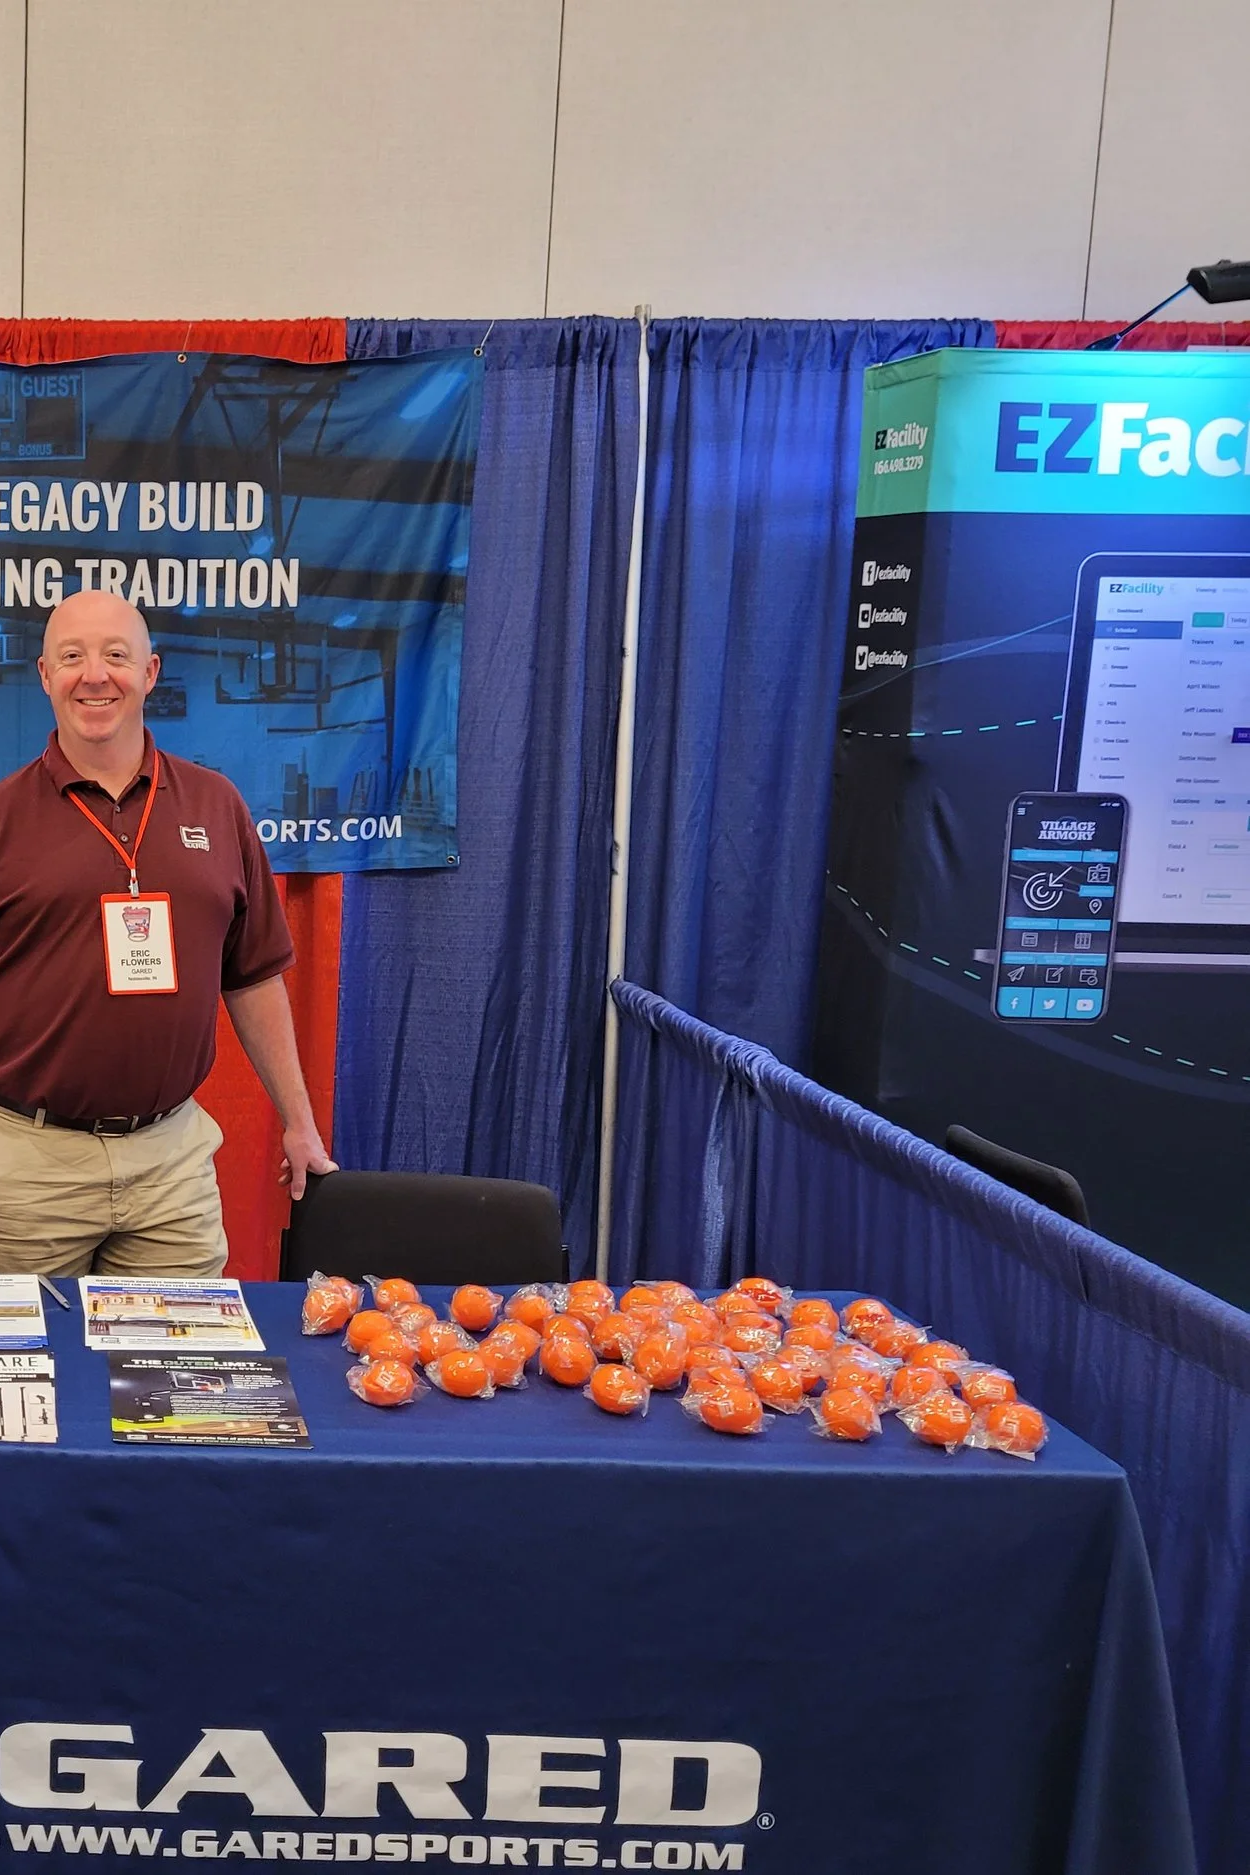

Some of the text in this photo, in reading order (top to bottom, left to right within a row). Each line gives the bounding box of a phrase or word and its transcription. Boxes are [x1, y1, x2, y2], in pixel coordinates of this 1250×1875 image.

[21, 375, 80, 397] GUEST
[875, 422, 928, 450] EZFacility
[995, 401, 1250, 477] EZFac
[18, 444, 52, 456] BONUS
[139, 481, 265, 533] BUILD
[75, 558, 300, 608] TRADITION
[1110, 582, 1164, 596] EZFacility
[256, 815, 402, 842] ORTS.COM
[1038, 831, 1095, 841] ARMORY
[1040, 820, 1096, 831] VILLAGE
[121, 958, 162, 967] FLOWERS
[130, 950, 150, 958] ERIC
[5, 1823, 745, 1871] WWW.GAREDSPORTS.COM
